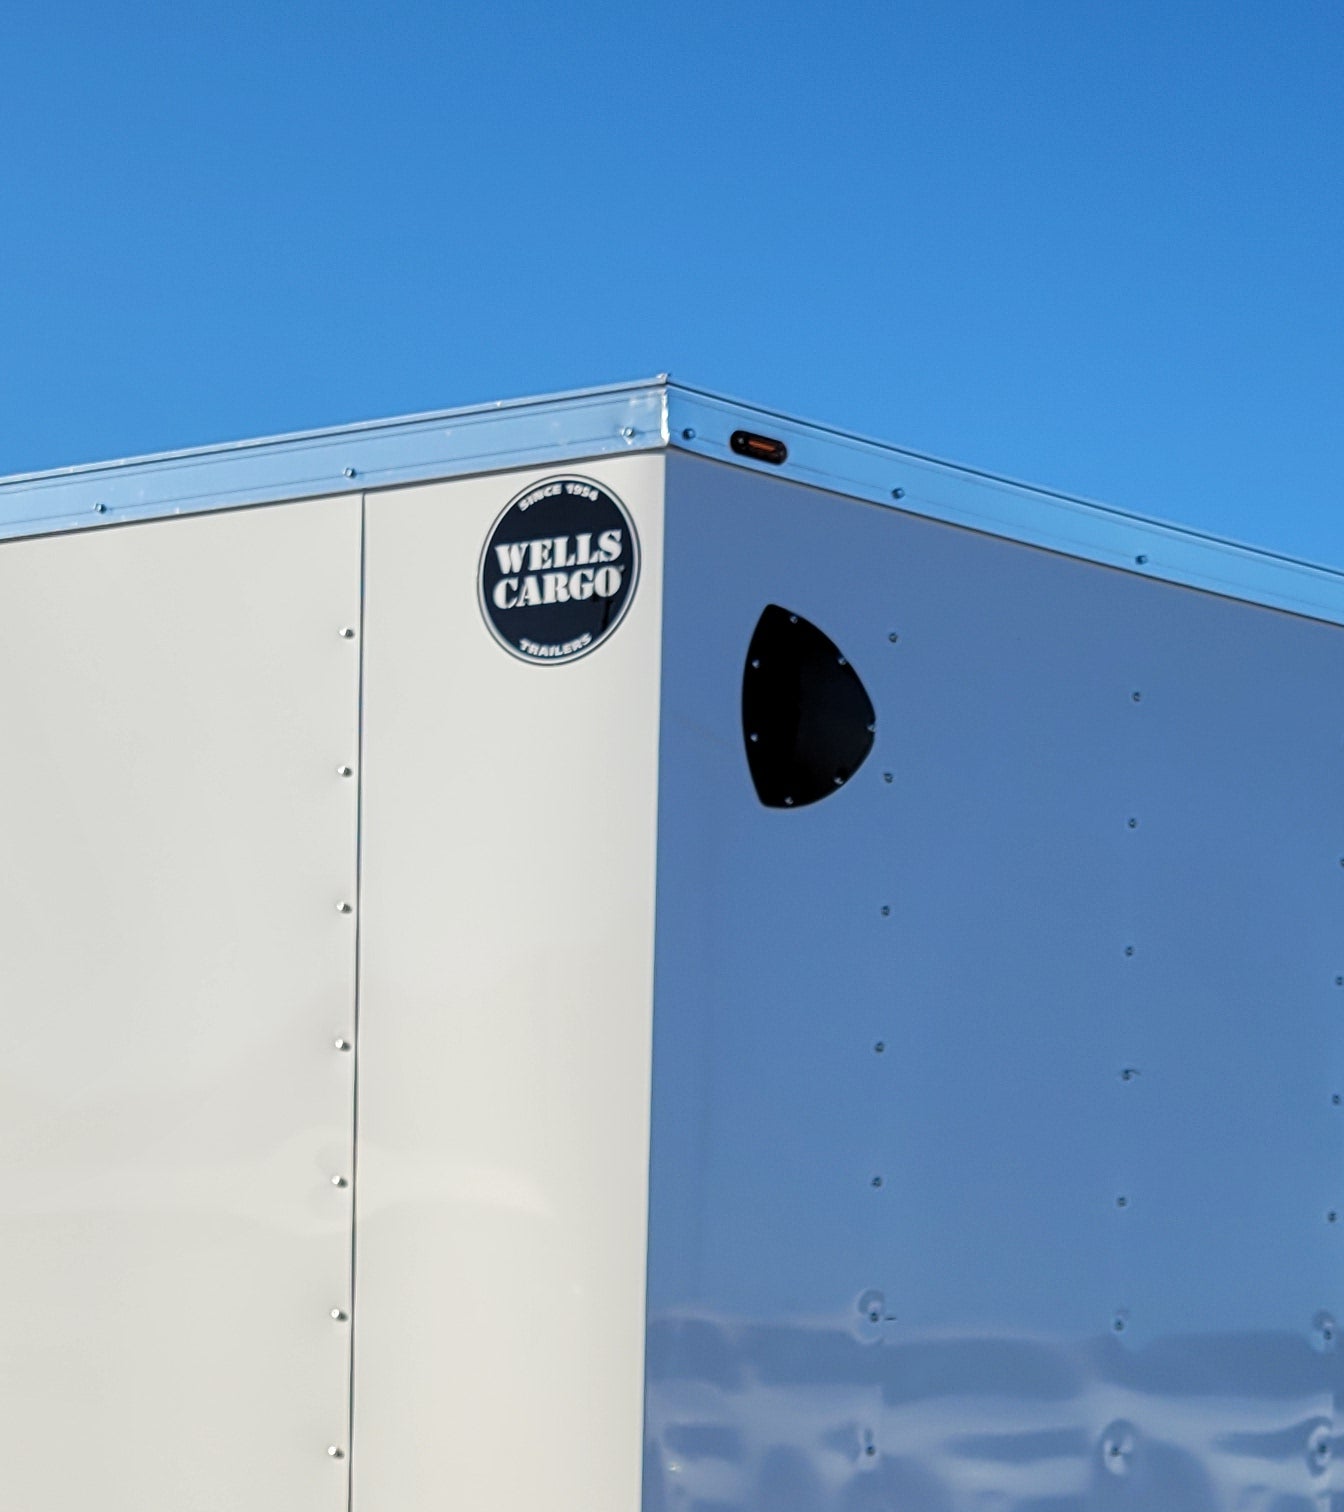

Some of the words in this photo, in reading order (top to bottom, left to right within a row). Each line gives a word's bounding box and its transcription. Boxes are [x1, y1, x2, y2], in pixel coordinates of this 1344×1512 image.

[518, 484, 561, 511] SINCE
[494, 528, 624, 575] WELLS
[492, 565, 623, 610] CARGO
[520, 633, 592, 656] TRAILERS
